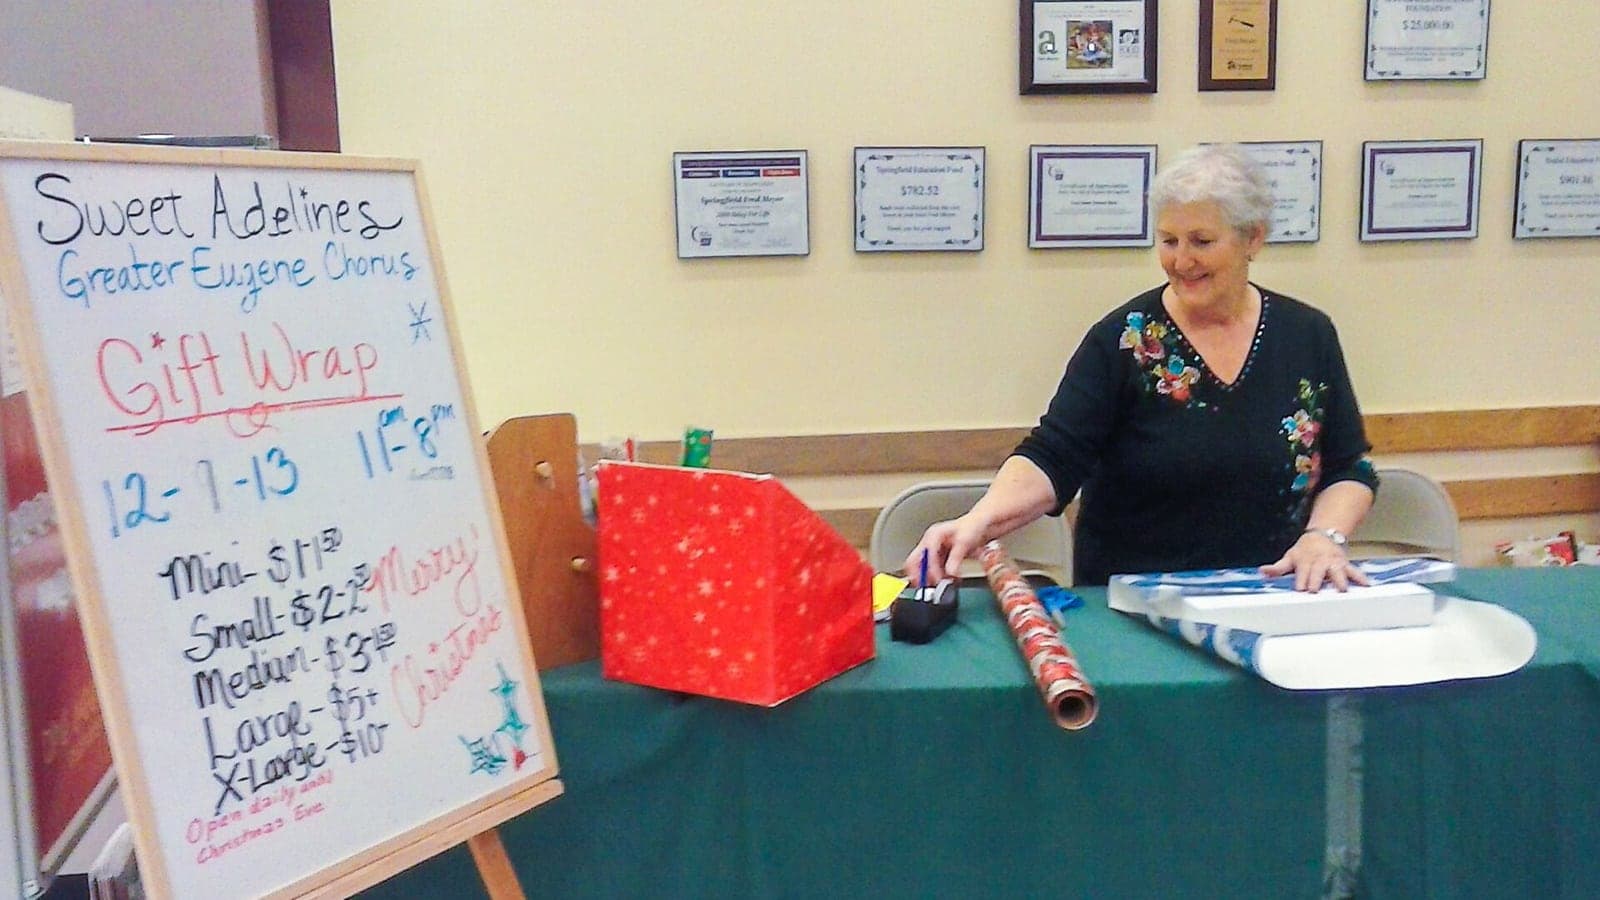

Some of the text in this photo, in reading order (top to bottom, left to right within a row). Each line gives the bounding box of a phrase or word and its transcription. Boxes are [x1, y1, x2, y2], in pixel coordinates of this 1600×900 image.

[34, 172, 403, 245] Sweet Adelines
[56, 241, 419, 313] Greater Eugene Chorus
[96, 322, 379, 431] Gift Wrap
[366, 523, 481, 618] Merry
[186, 810, 242, 843] Open
[249, 786, 295, 815] daily
[197, 802, 325, 864] Christmas Eve
